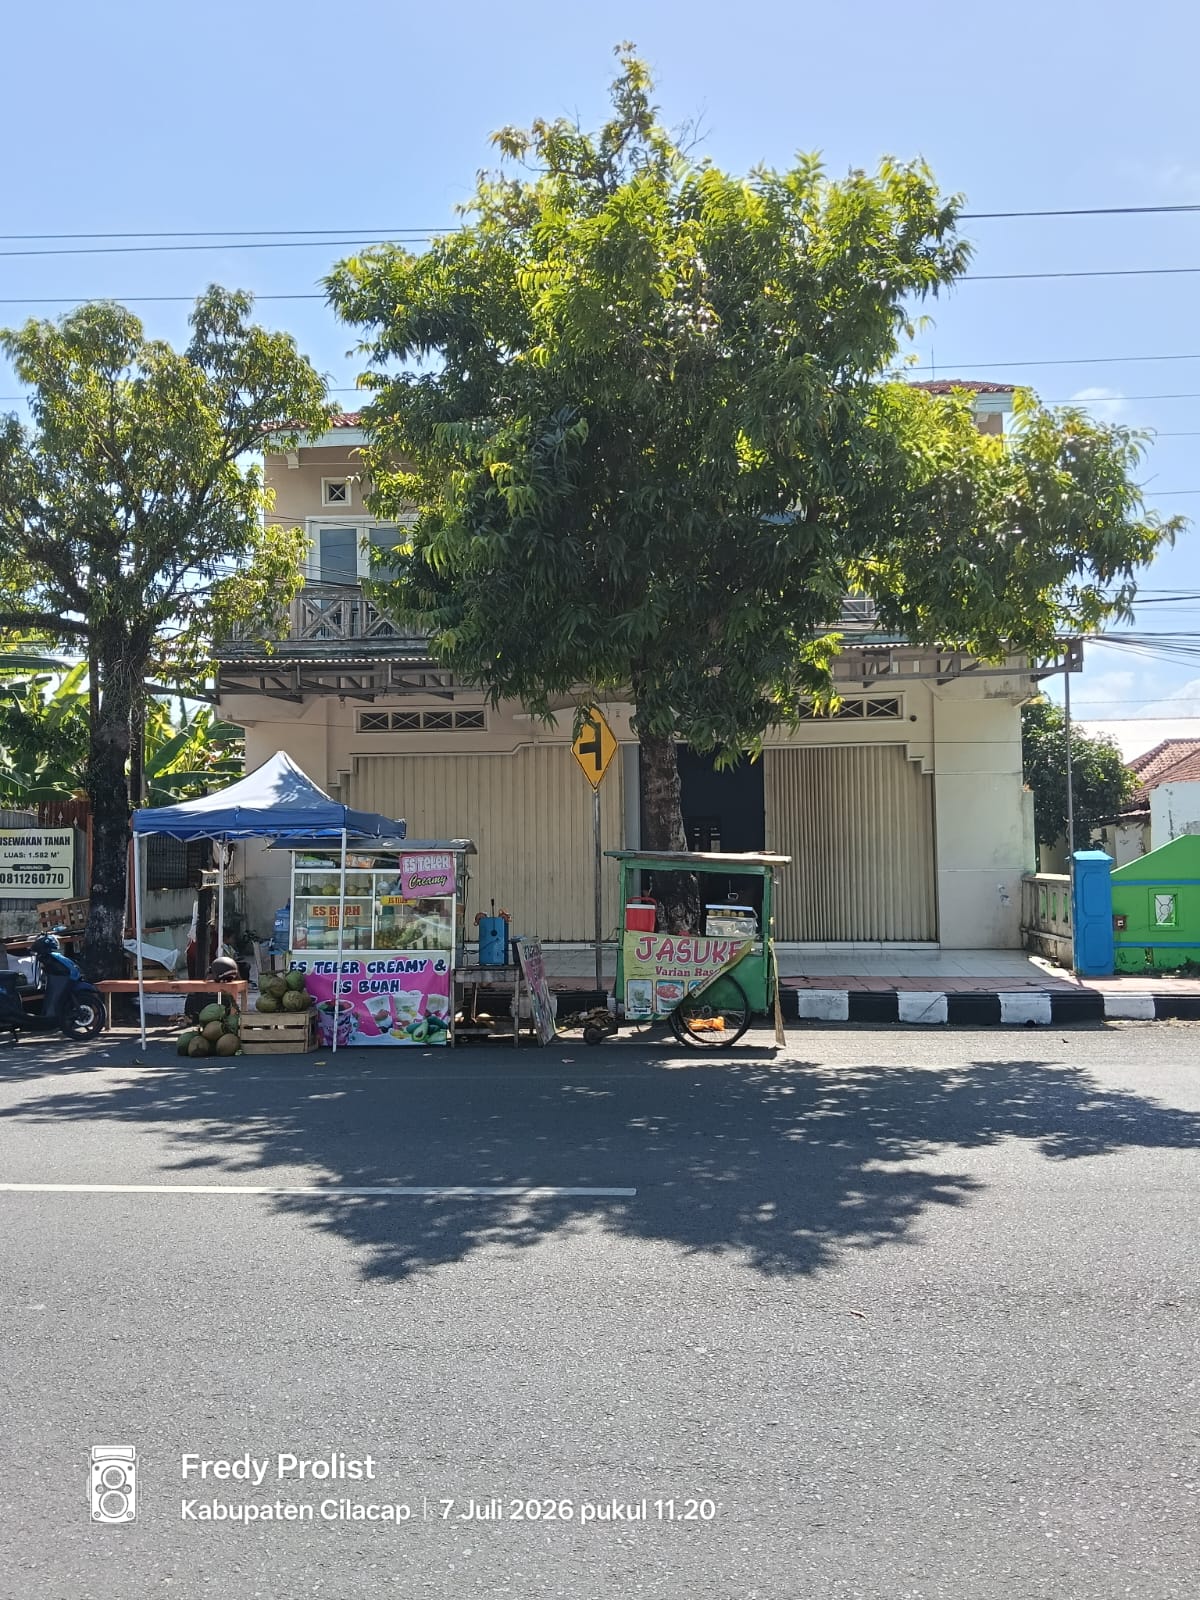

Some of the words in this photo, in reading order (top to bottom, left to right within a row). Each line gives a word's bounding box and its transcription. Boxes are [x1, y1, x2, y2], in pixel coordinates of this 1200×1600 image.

[44, 836, 70, 846] TANAH
[0, 873, 64, 884] 0811260770
[408, 873, 448, 889] Creamy
[312, 906, 326, 916] ES
[289, 961, 307, 973] ES
[367, 960, 427, 973] CREAMY
[434, 960, 447, 972] &
[655, 966, 691, 977] Varian
[360, 980, 400, 993] BUAH
